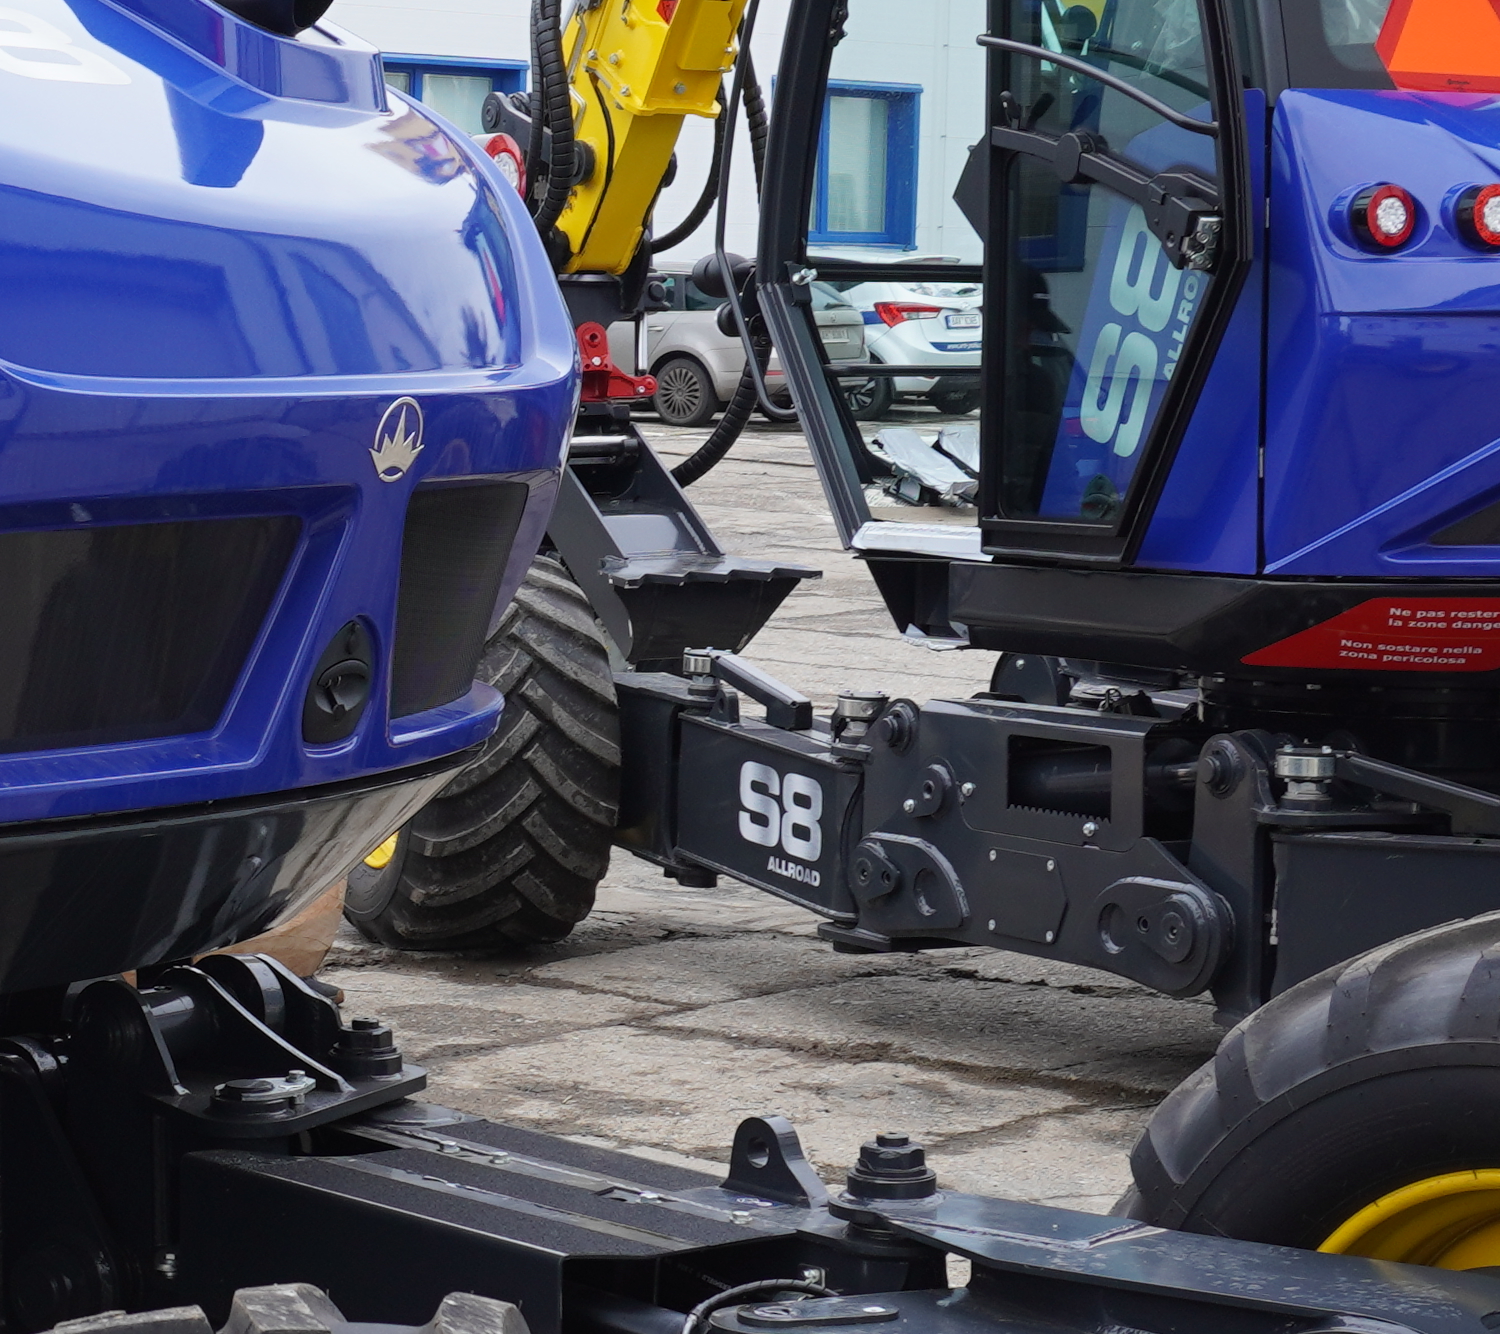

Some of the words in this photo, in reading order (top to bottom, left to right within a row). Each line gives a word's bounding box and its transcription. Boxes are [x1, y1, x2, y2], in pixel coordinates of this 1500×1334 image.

[1162, 271, 1202, 382] ALLRO
[1389, 607, 1412, 619] Ne
[1416, 609, 1446, 620] pas
[1450, 608, 1500, 619] rester
[1388, 618, 1404, 628] la
[1408, 620, 1448, 629] zone
[1340, 639, 1373, 650] Non
[1377, 642, 1439, 654] sostare
[1442, 644, 1482, 655] nella
[1339, 650, 1379, 660] zona
[1382, 653, 1467, 665] pericolosa
[737, 760, 824, 862] S8
[767, 854, 822, 888] ALLROAD
